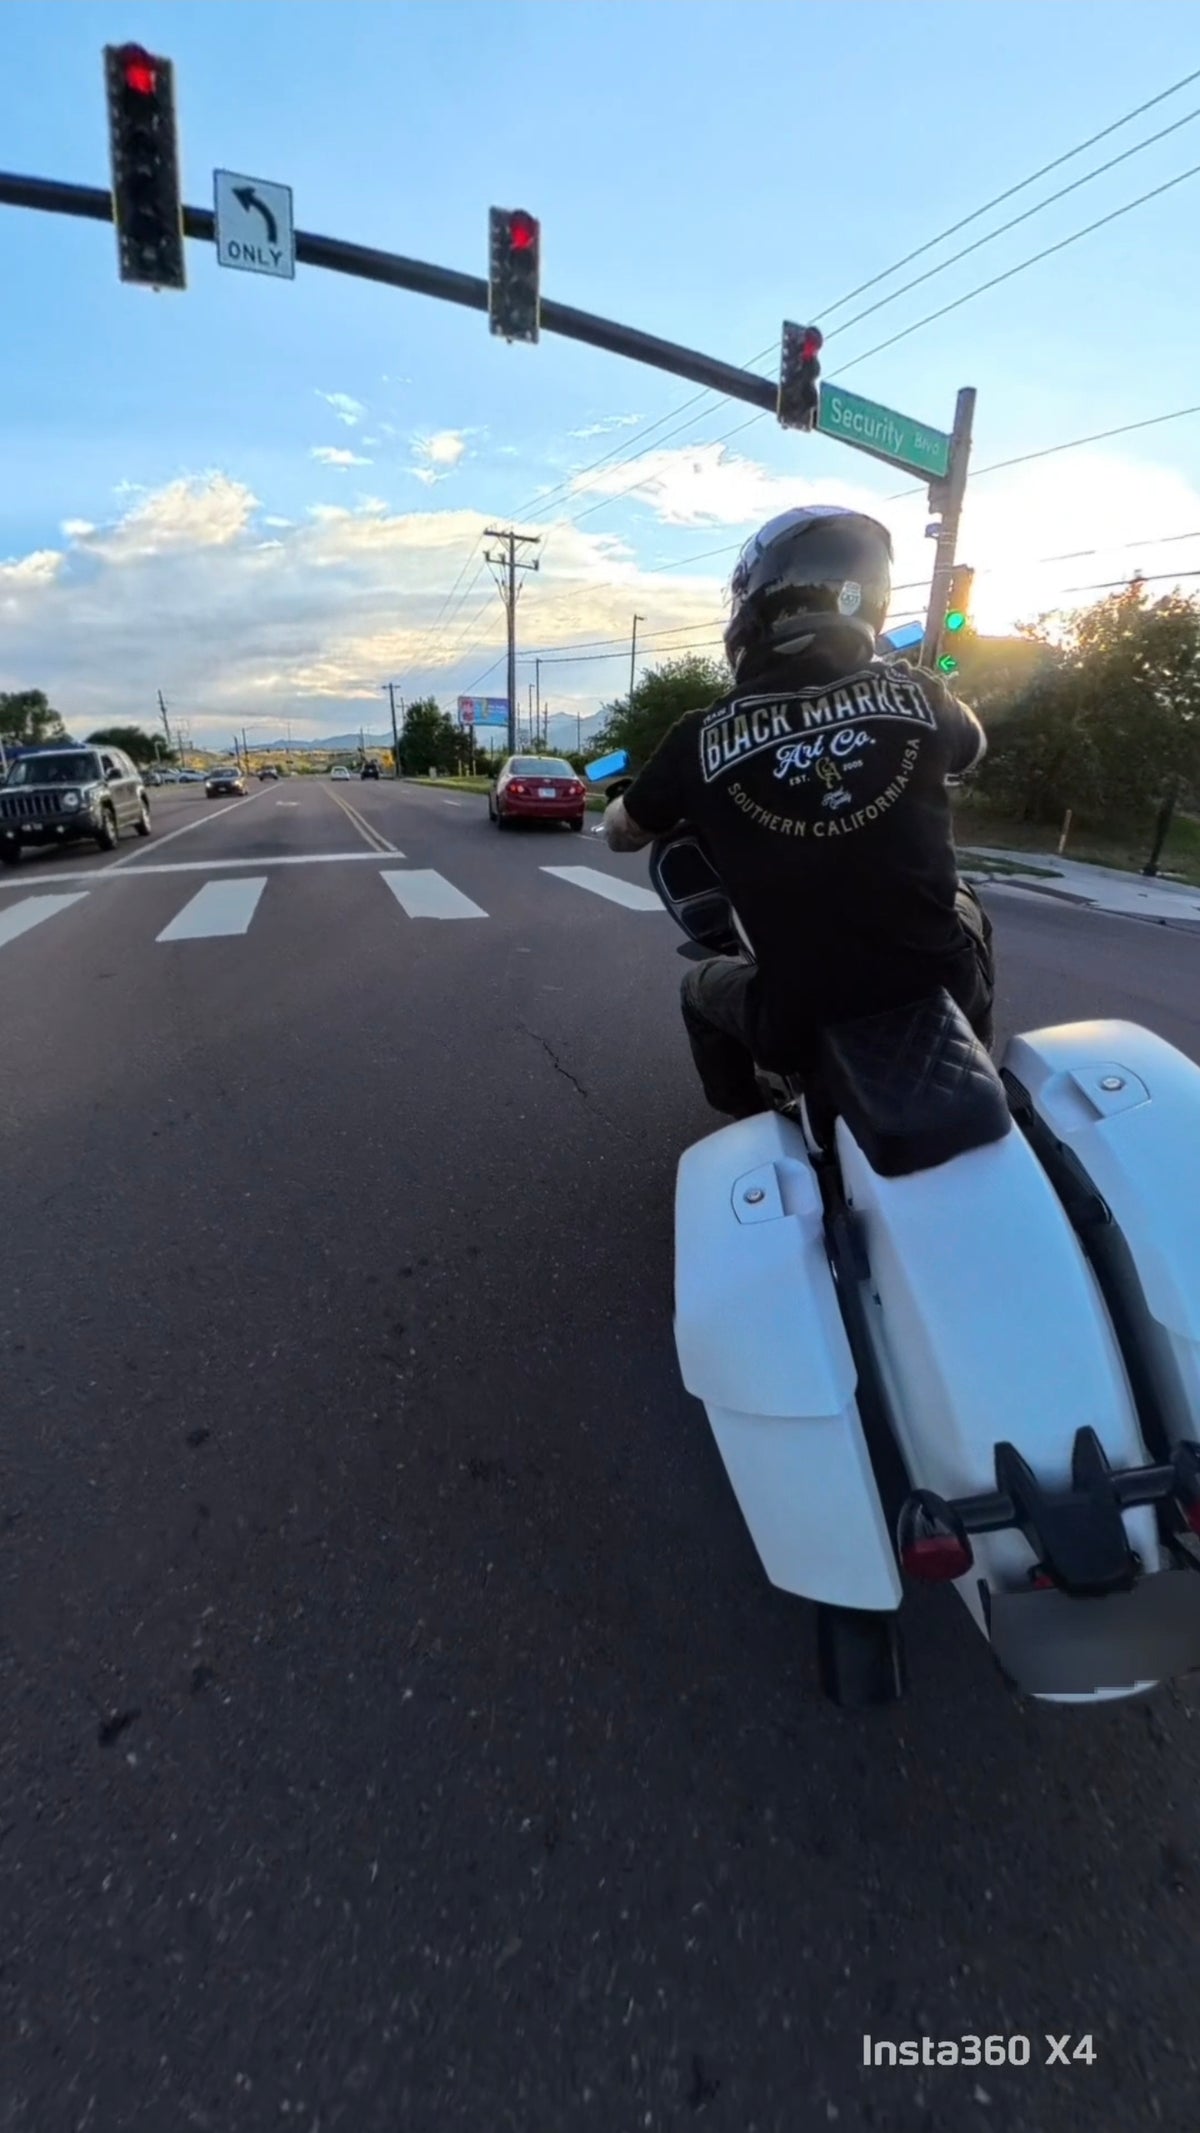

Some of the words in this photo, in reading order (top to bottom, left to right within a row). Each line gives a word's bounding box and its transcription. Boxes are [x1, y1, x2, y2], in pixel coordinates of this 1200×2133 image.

[228, 240, 282, 267] ONLY
[831, 399, 904, 452] Security
[706, 703, 792, 772] BLACK
[801, 679, 927, 728] MARKET
[773, 735, 825, 779] Art
[830, 728, 876, 757] Co.
[727, 782, 806, 837] SOUTHERN
